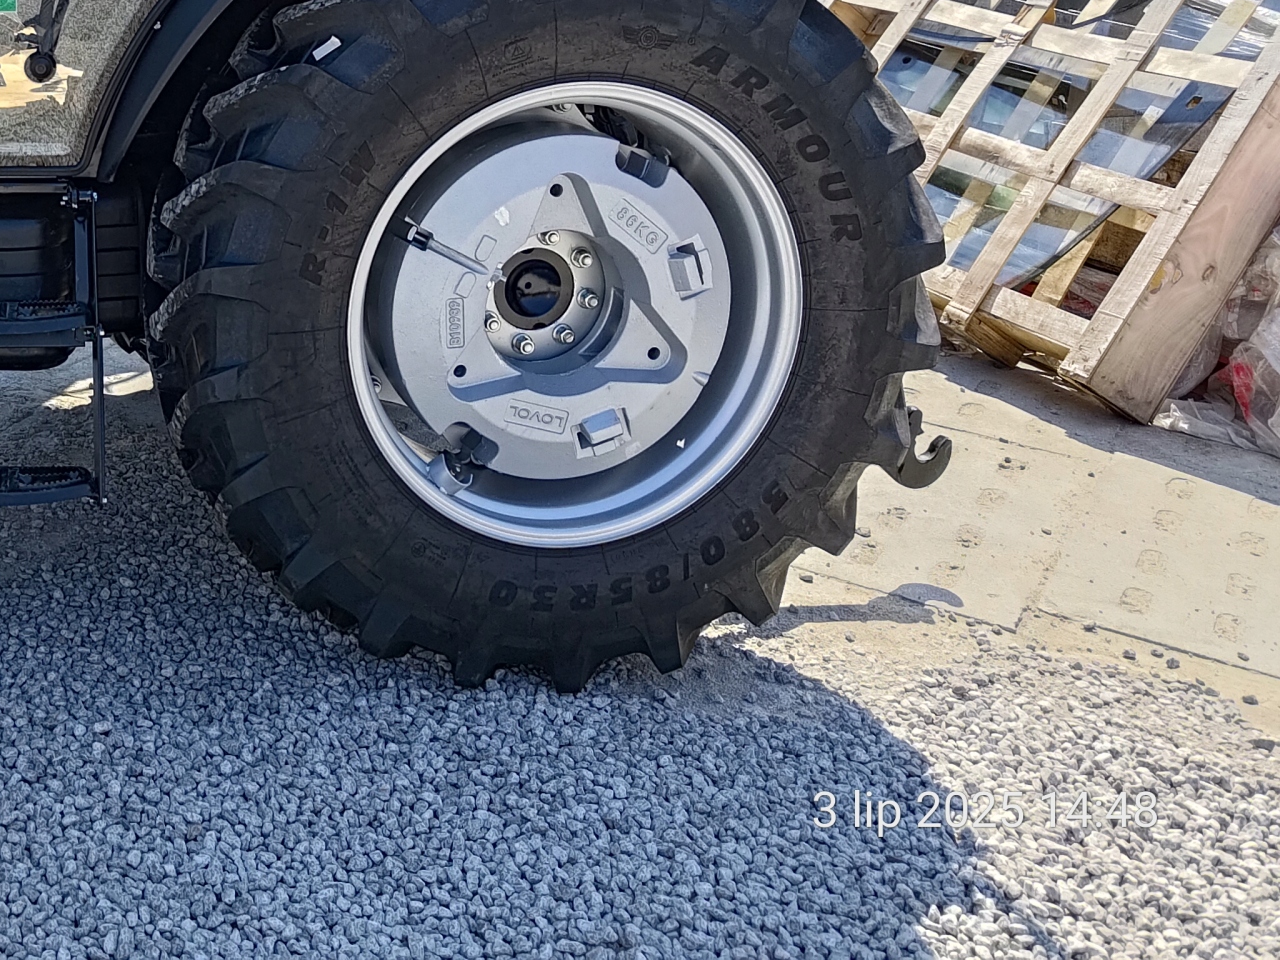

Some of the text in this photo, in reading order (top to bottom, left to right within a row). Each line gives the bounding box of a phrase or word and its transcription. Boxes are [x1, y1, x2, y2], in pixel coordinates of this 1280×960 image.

[689, 45, 863, 243] ARMOUR
[616, 207, 660, 246] 86KG
[509, 404, 565, 428] LOVOL
[487, 481, 790, 612] 380/85R30
